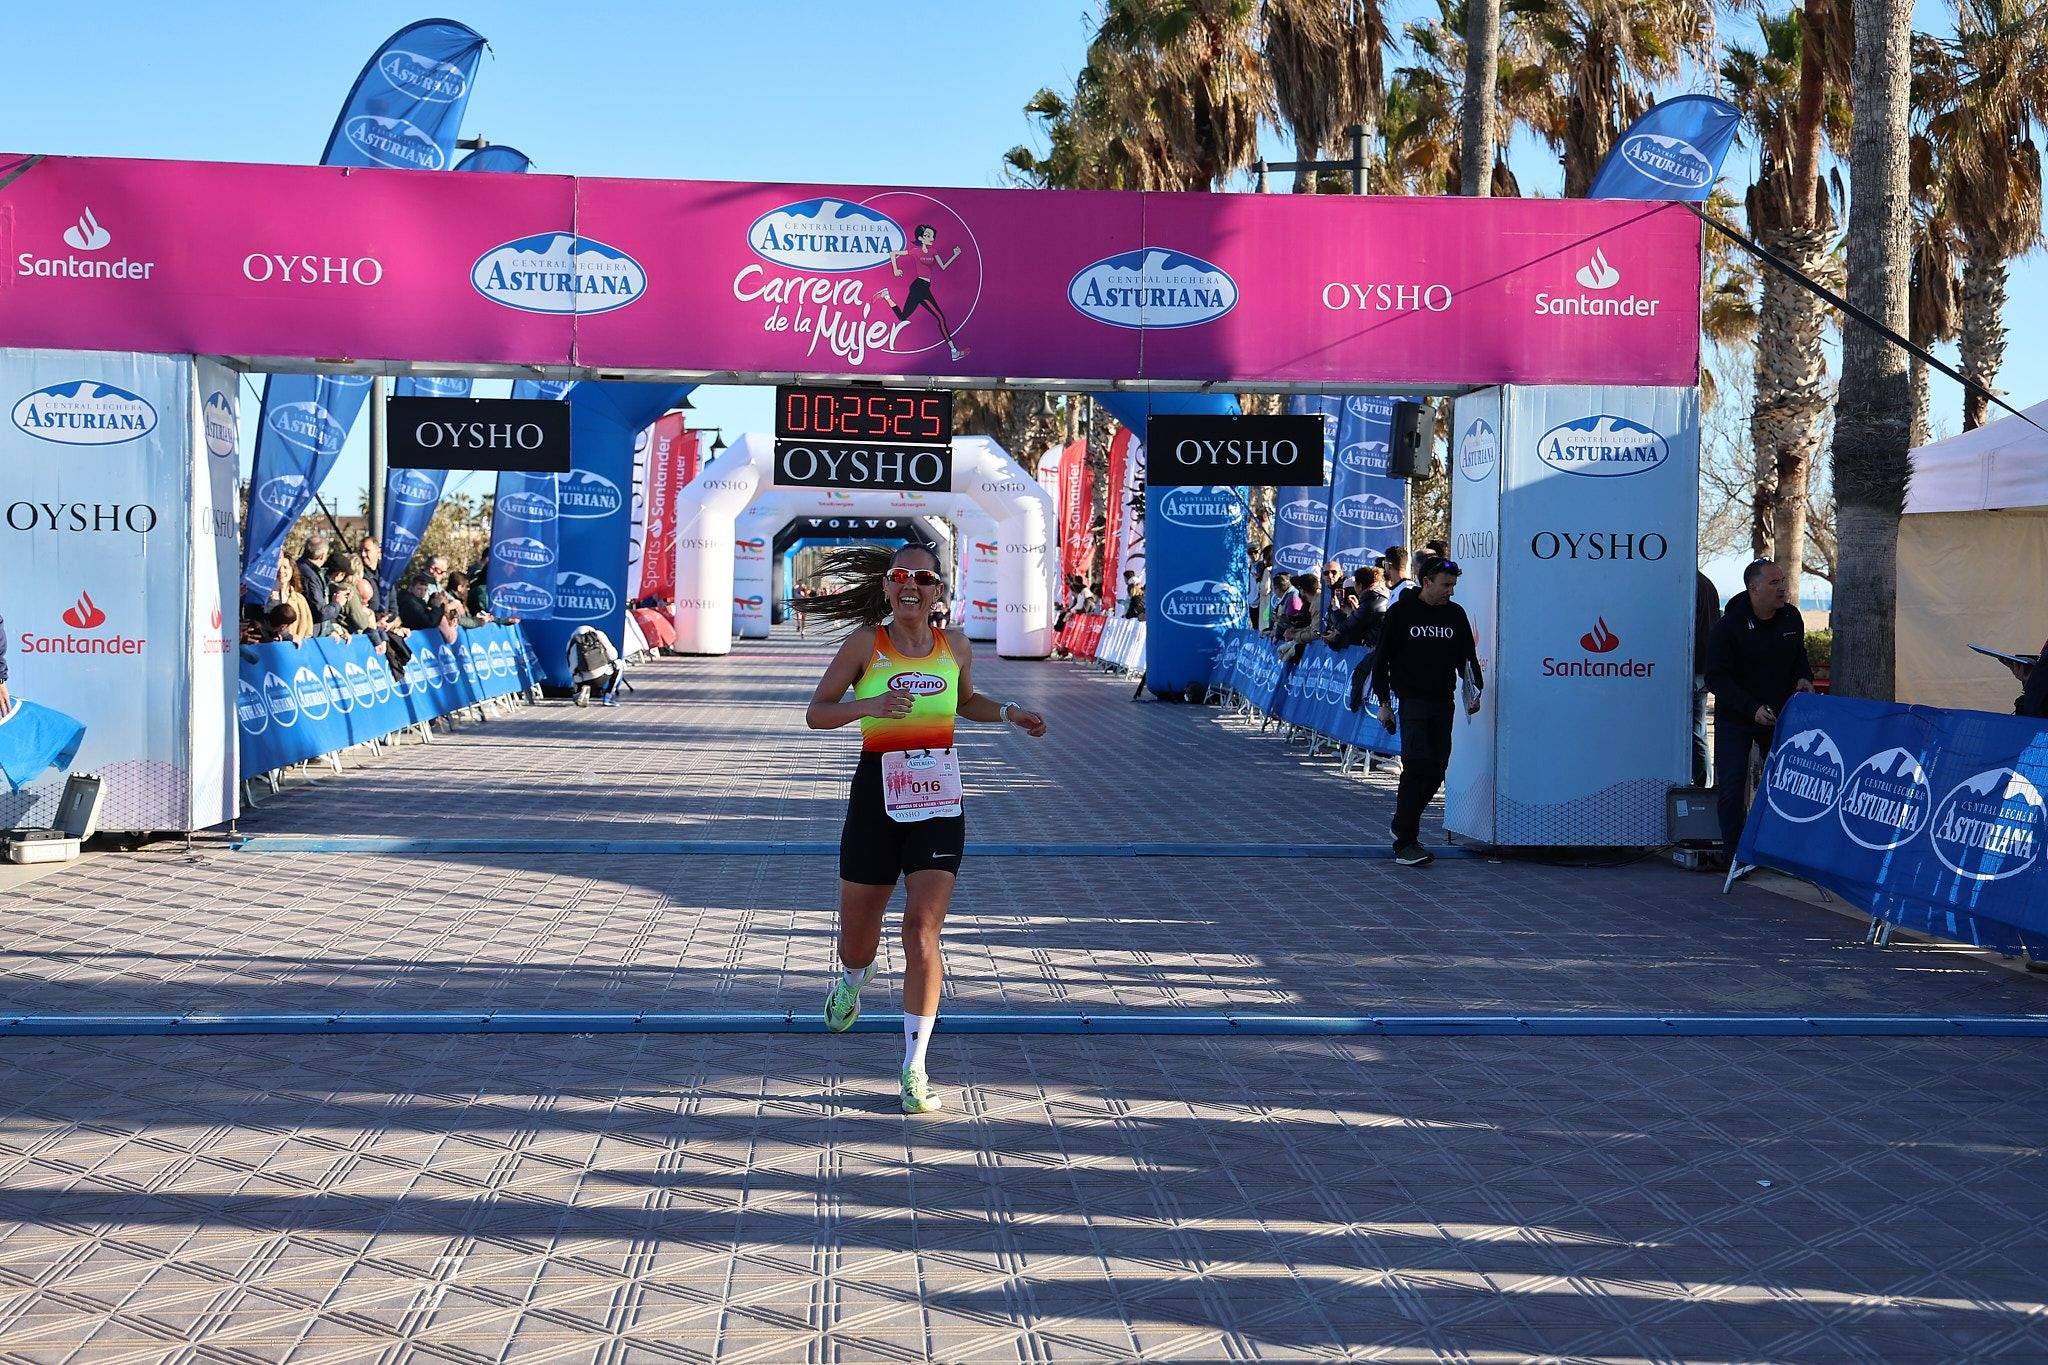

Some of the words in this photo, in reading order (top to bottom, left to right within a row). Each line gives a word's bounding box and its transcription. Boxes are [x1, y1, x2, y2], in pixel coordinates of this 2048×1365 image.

[350, 122, 434, 168] ASTURIANA
[1626, 141, 1703, 183] ASTURIANA
[760, 223, 893, 254] ASTURIANA
[784, 222, 833, 231] CENTRAL
[839, 223, 889, 232] LECHERA
[18, 253, 154, 280] Santander
[243, 253, 382, 286] OYSHO
[512, 259, 567, 269] CENTRAL
[485, 260, 633, 295] ASTURIANA
[733, 264, 863, 307] Carrera
[1108, 275, 1161, 284] CENTRAL
[1166, 276, 1220, 285] LECHERA
[1081, 277, 1225, 308] ASTURIANA
[1322, 282, 1453, 312] OYSHO
[1535, 293, 1660, 317] Santander
[764, 306, 788, 332] de
[794, 306, 811, 332] la
[807, 303, 911, 366] Mujer
[23, 403, 147, 430] ASTURIANA
[46, 402, 93, 410] CENTRAL
[788, 394, 940, 437] 00:25:25
[1352, 399, 1393, 416] ASTURI
[416, 421, 544, 450] OYSHO
[1175, 439, 1298, 466] OYSHO
[1342, 451, 1391, 469] ASTURI
[1547, 437, 1659, 462] ASTURIANA
[652, 436, 672, 516] Santander
[783, 447, 944, 485] OYSHO
[703, 480, 748, 490] OYSHO
[982, 482, 1026, 493] OYSHO
[7, 502, 157, 533] OYSHO
[503, 500, 554, 517] ASTURIANA
[1166, 498, 1240, 516] ASTURIA
[1338, 503, 1399, 524] ASTURIANA
[203, 505, 235, 540] OSHO
[808, 518, 897, 529] VOLVO
[499, 545, 550, 563] ASTURIANA
[1457, 530, 1493, 560] OYSHO
[1531, 531, 1668, 561] OYSHO
[644, 541, 661, 589] Sports
[494, 591, 549, 607] ASTURIANA
[1006, 604, 1040, 613] OYSH
[1167, 597, 1240, 615] ASTURIA
[21, 633, 146, 655] Santander
[1410, 625, 1454, 639] OYSHO
[1542, 657, 1656, 678] Santander
[894, 677, 943, 689] Serrano
[912, 780, 941, 794] 016
[1770, 754, 1834, 805] ASTURIANA
[1864, 778, 1891, 792] CENTRAL
[1842, 777, 1919, 832] ASTURIANA
[1961, 801, 1997, 816] CENTRAL
[1936, 801, 2034, 858] ASTURIANA
